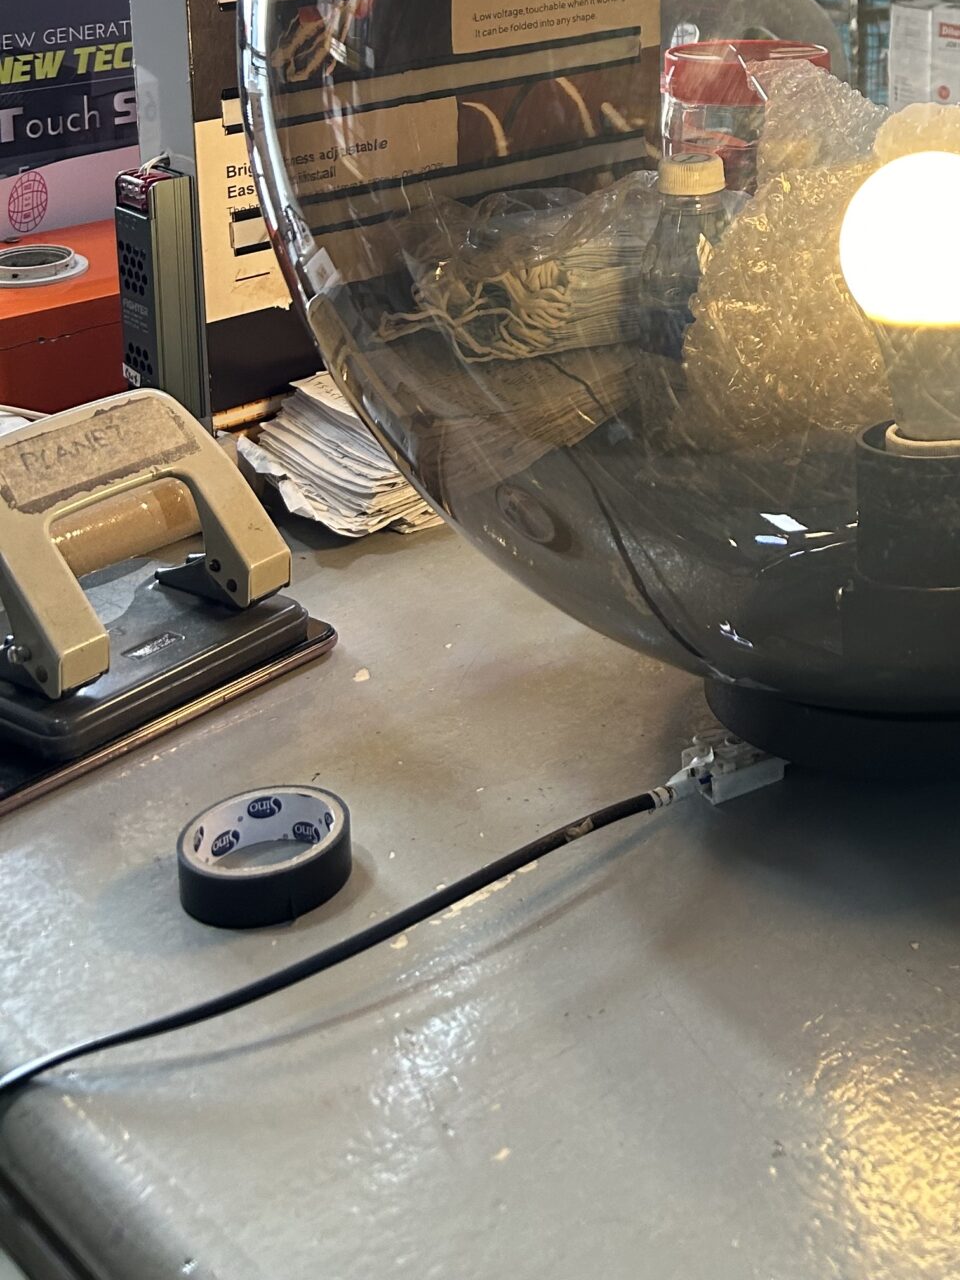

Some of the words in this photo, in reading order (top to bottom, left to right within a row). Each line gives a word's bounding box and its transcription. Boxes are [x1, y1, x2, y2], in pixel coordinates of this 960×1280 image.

[0, 30, 35, 51] EW
[43, 20, 132, 45] GENERAT
[482, 28, 497, 38] can
[510, 20, 539, 33] folded
[539, 18, 555, 29] into
[556, 17, 570, 27] any
[0, 49, 65, 85] NEW
[73, 40, 134, 77] TEC
[0, 95, 100, 144] Touch
[249, 796, 282, 816] Sino
[212, 830, 240, 852] Sino
[295, 823, 321, 844] Sino
